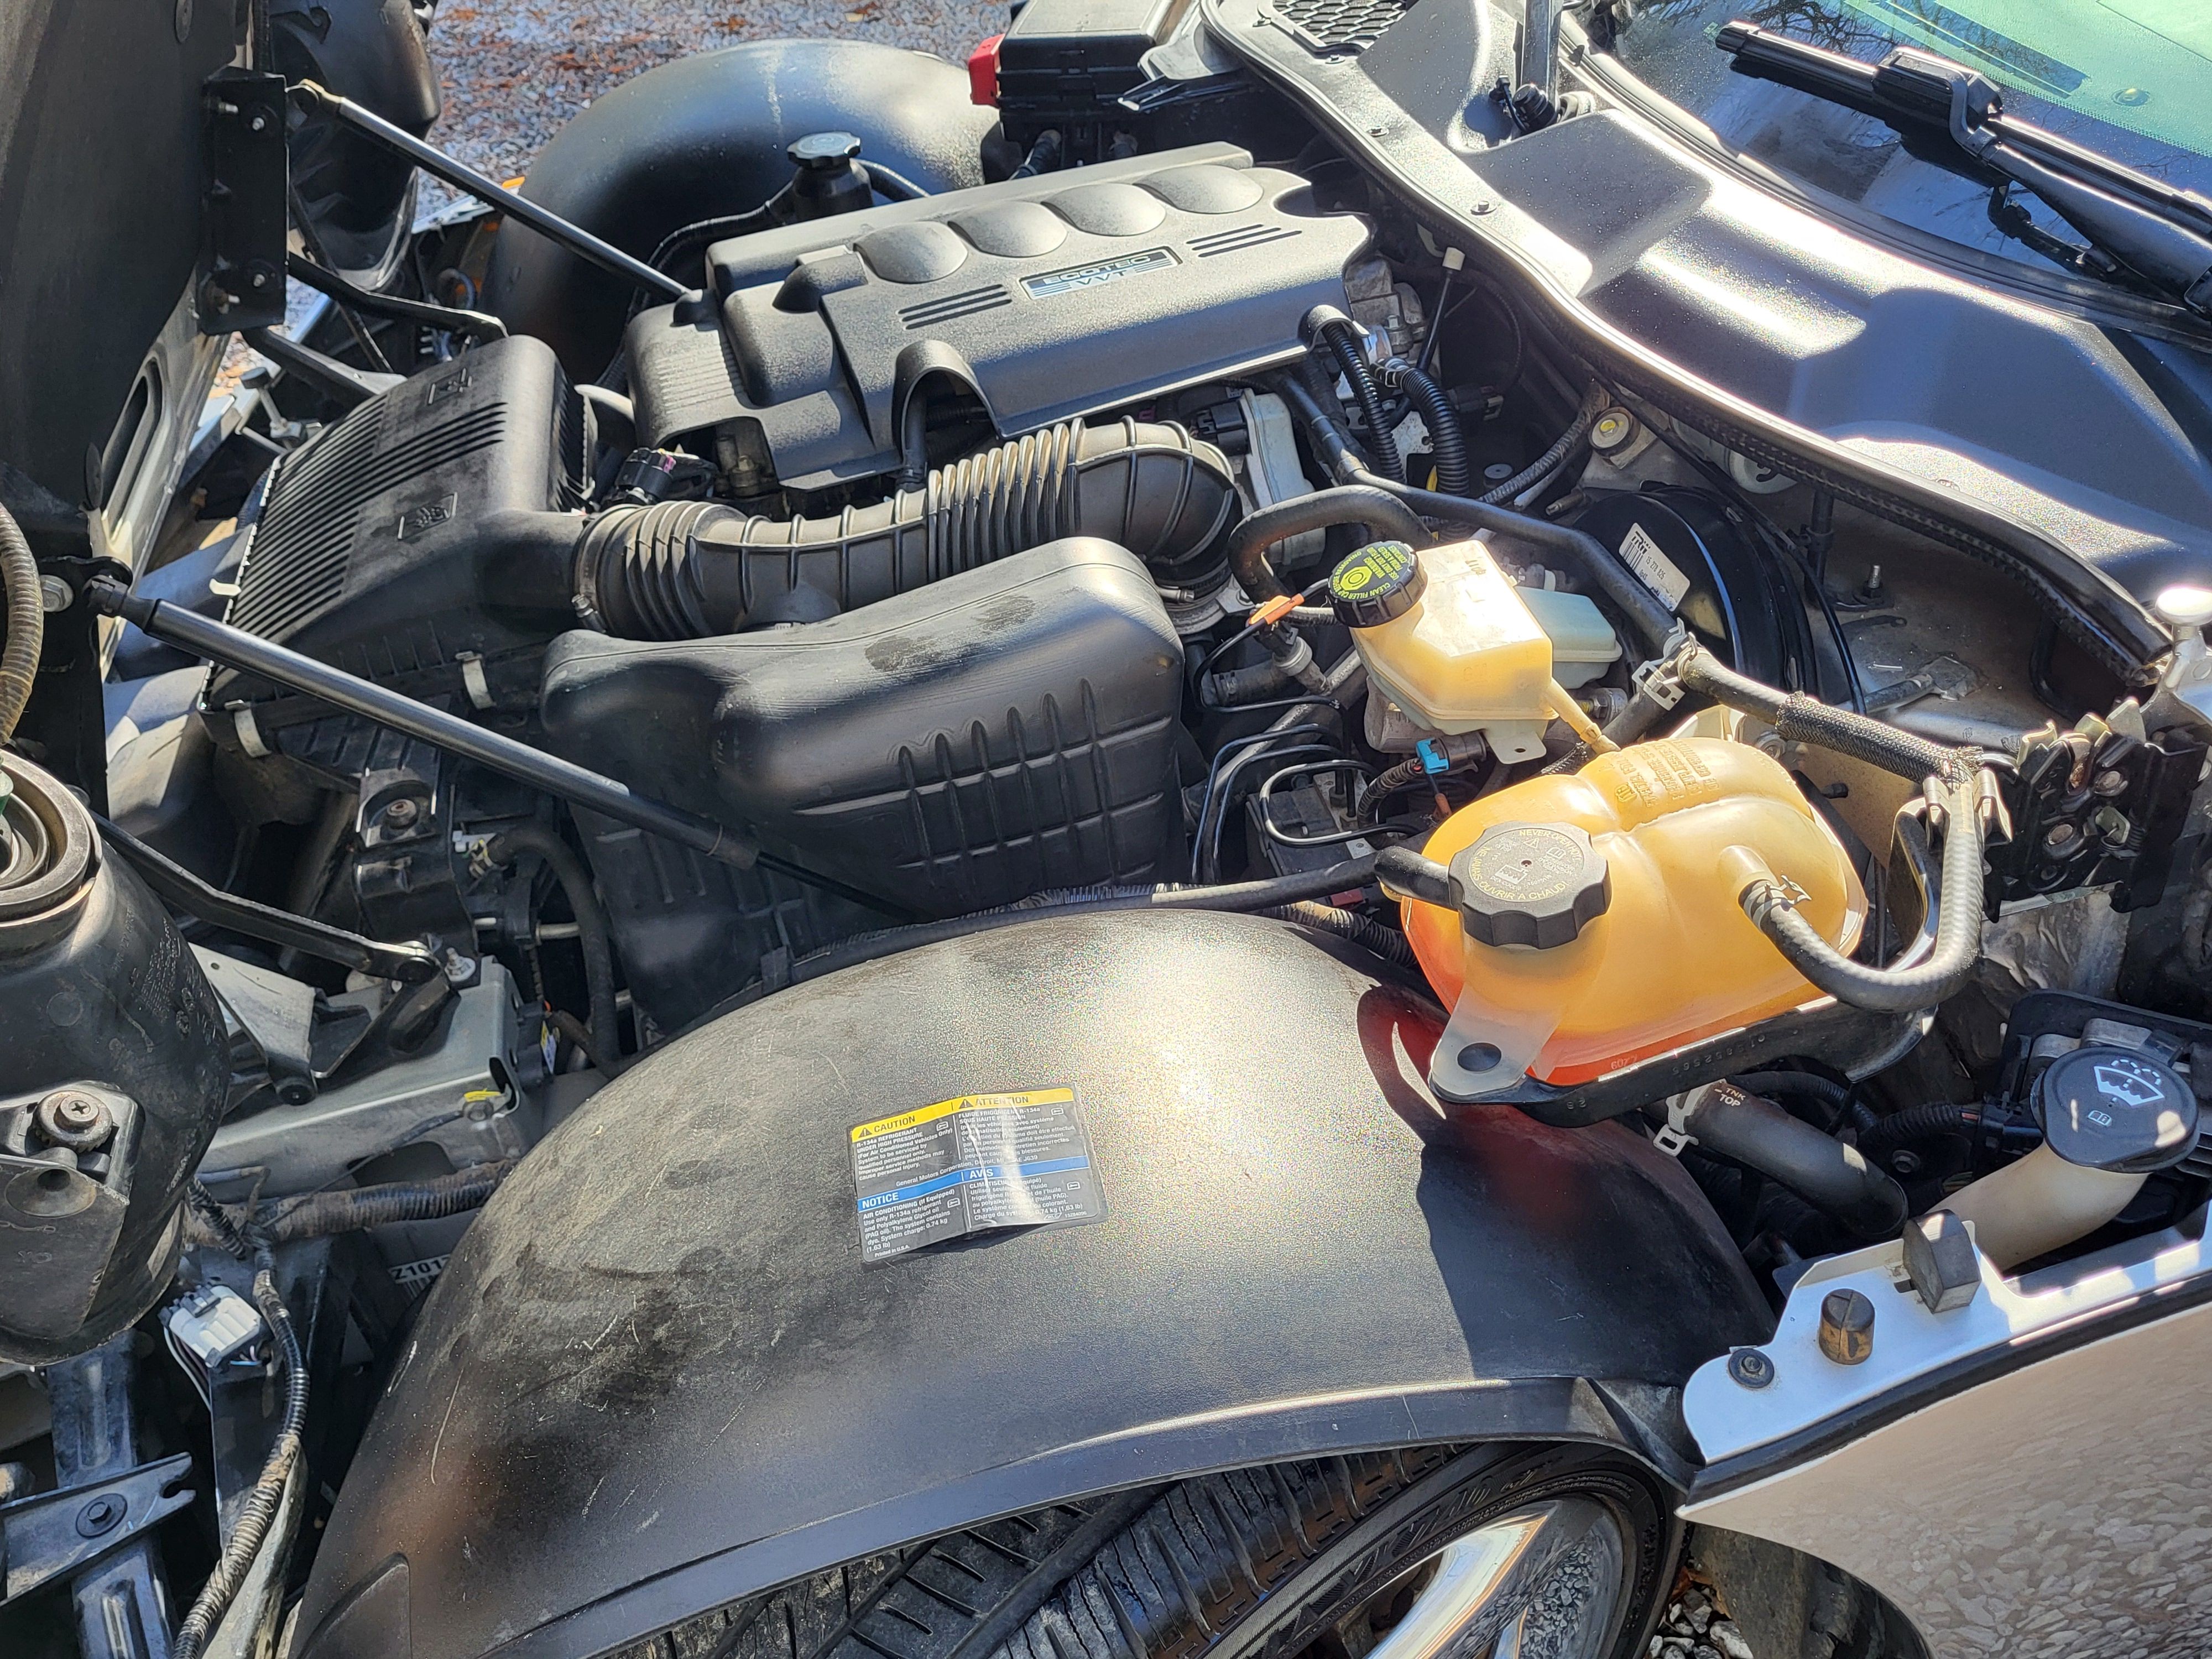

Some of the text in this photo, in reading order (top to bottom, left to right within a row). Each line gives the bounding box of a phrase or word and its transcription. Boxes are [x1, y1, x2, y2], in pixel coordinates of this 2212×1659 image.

[1043, 255, 1152, 285] ECOTEC
[1076, 270, 1131, 285] VVT
[1367, 547, 1378, 556] FLUID
[1630, 531, 1651, 555] TRW
[1375, 557, 1386, 565] DOT
[1378, 546, 1391, 559] SEALED
[1388, 545, 1407, 564] CONTAINER
[1335, 551, 1361, 576] REMOVING
[1363, 556, 1386, 579] WARNING!
[1382, 563, 1393, 573] ONLY
[1390, 559, 1404, 571] FROM
[1333, 576, 1342, 592] BEFORE
[1389, 570, 1400, 581] USE
[1338, 590, 1349, 599] CAP
[1369, 582, 1391, 596] CLEAN
[1520, 829, 1551, 837] NEVER
[1552, 834, 1571, 848] OPEN
[1475, 847, 1493, 859] NE
[1471, 855, 1483, 880] JAMAIS
[1479, 880, 1516, 899] OUVRIR
[1517, 892, 1526, 900] A
[1528, 881, 1568, 900] CHAUD!
[974, 1095, 1029, 1107] ATTENTION
[1719, 1094, 1741, 1107] TOP
[1725, 1087, 1746, 1101] TNK
[873, 1115, 915, 1134] CAUTION
[1029, 1116, 1055, 1124] système
[856, 1126, 917, 1148] R-134a REFRIGERANT
[857, 1131, 923, 1154] UNDER HIGH PRESSURE
[857, 1151, 869, 1160] (For
[879, 1139, 913, 1154] Conditioned
[914, 1133, 937, 1144] Vehicles
[938, 1127, 953, 1137] Only)
[1037, 1138, 1070, 1146] incorrectes
[857, 1155, 879, 1166] System
[895, 1144, 919, 1156] serviced
[858, 1149, 925, 1171] qualified personnel only.
[858, 1149, 945, 1177] Improper service methods may
[859, 1172, 876, 1181] cause
[877, 1166, 901, 1177] personal
[895, 1176, 917, 1187] General
[919, 1171, 938, 1181] Motors
[940, 1161, 973, 1175] Corporation,
[862, 1192, 899, 1209] NOTICE
[862, 1211, 874, 1220] AIR
[874, 1200, 917, 1217] CONDITIONING
[926, 1188, 955, 1202] Equipped)
[981, 1204, 1007, 1213] système
[875, 1214, 888, 1224] only
[889, 1209, 910, 1219] R-134a
[911, 1199, 942, 1214] refrigerant
[876, 1214, 912, 1230] Polyalkylene
[914, 1209, 931, 1220] Glycol
[973, 1212, 995, 1220] Charge
[864, 1209, 950, 1240] (PAG oil). The system contains
[867, 1237, 879, 1245] dye.
[880, 1230, 902, 1243] System
[903, 1224, 925, 1237] charge:
[925, 1220, 938, 1228] 0.74
[865, 1240, 890, 1254] (1.63 lb)
[874, 1249, 890, 1258] Printed
[896, 1243, 910, 1251] U.S.A.
[391, 1256, 451, 1280] Z101
